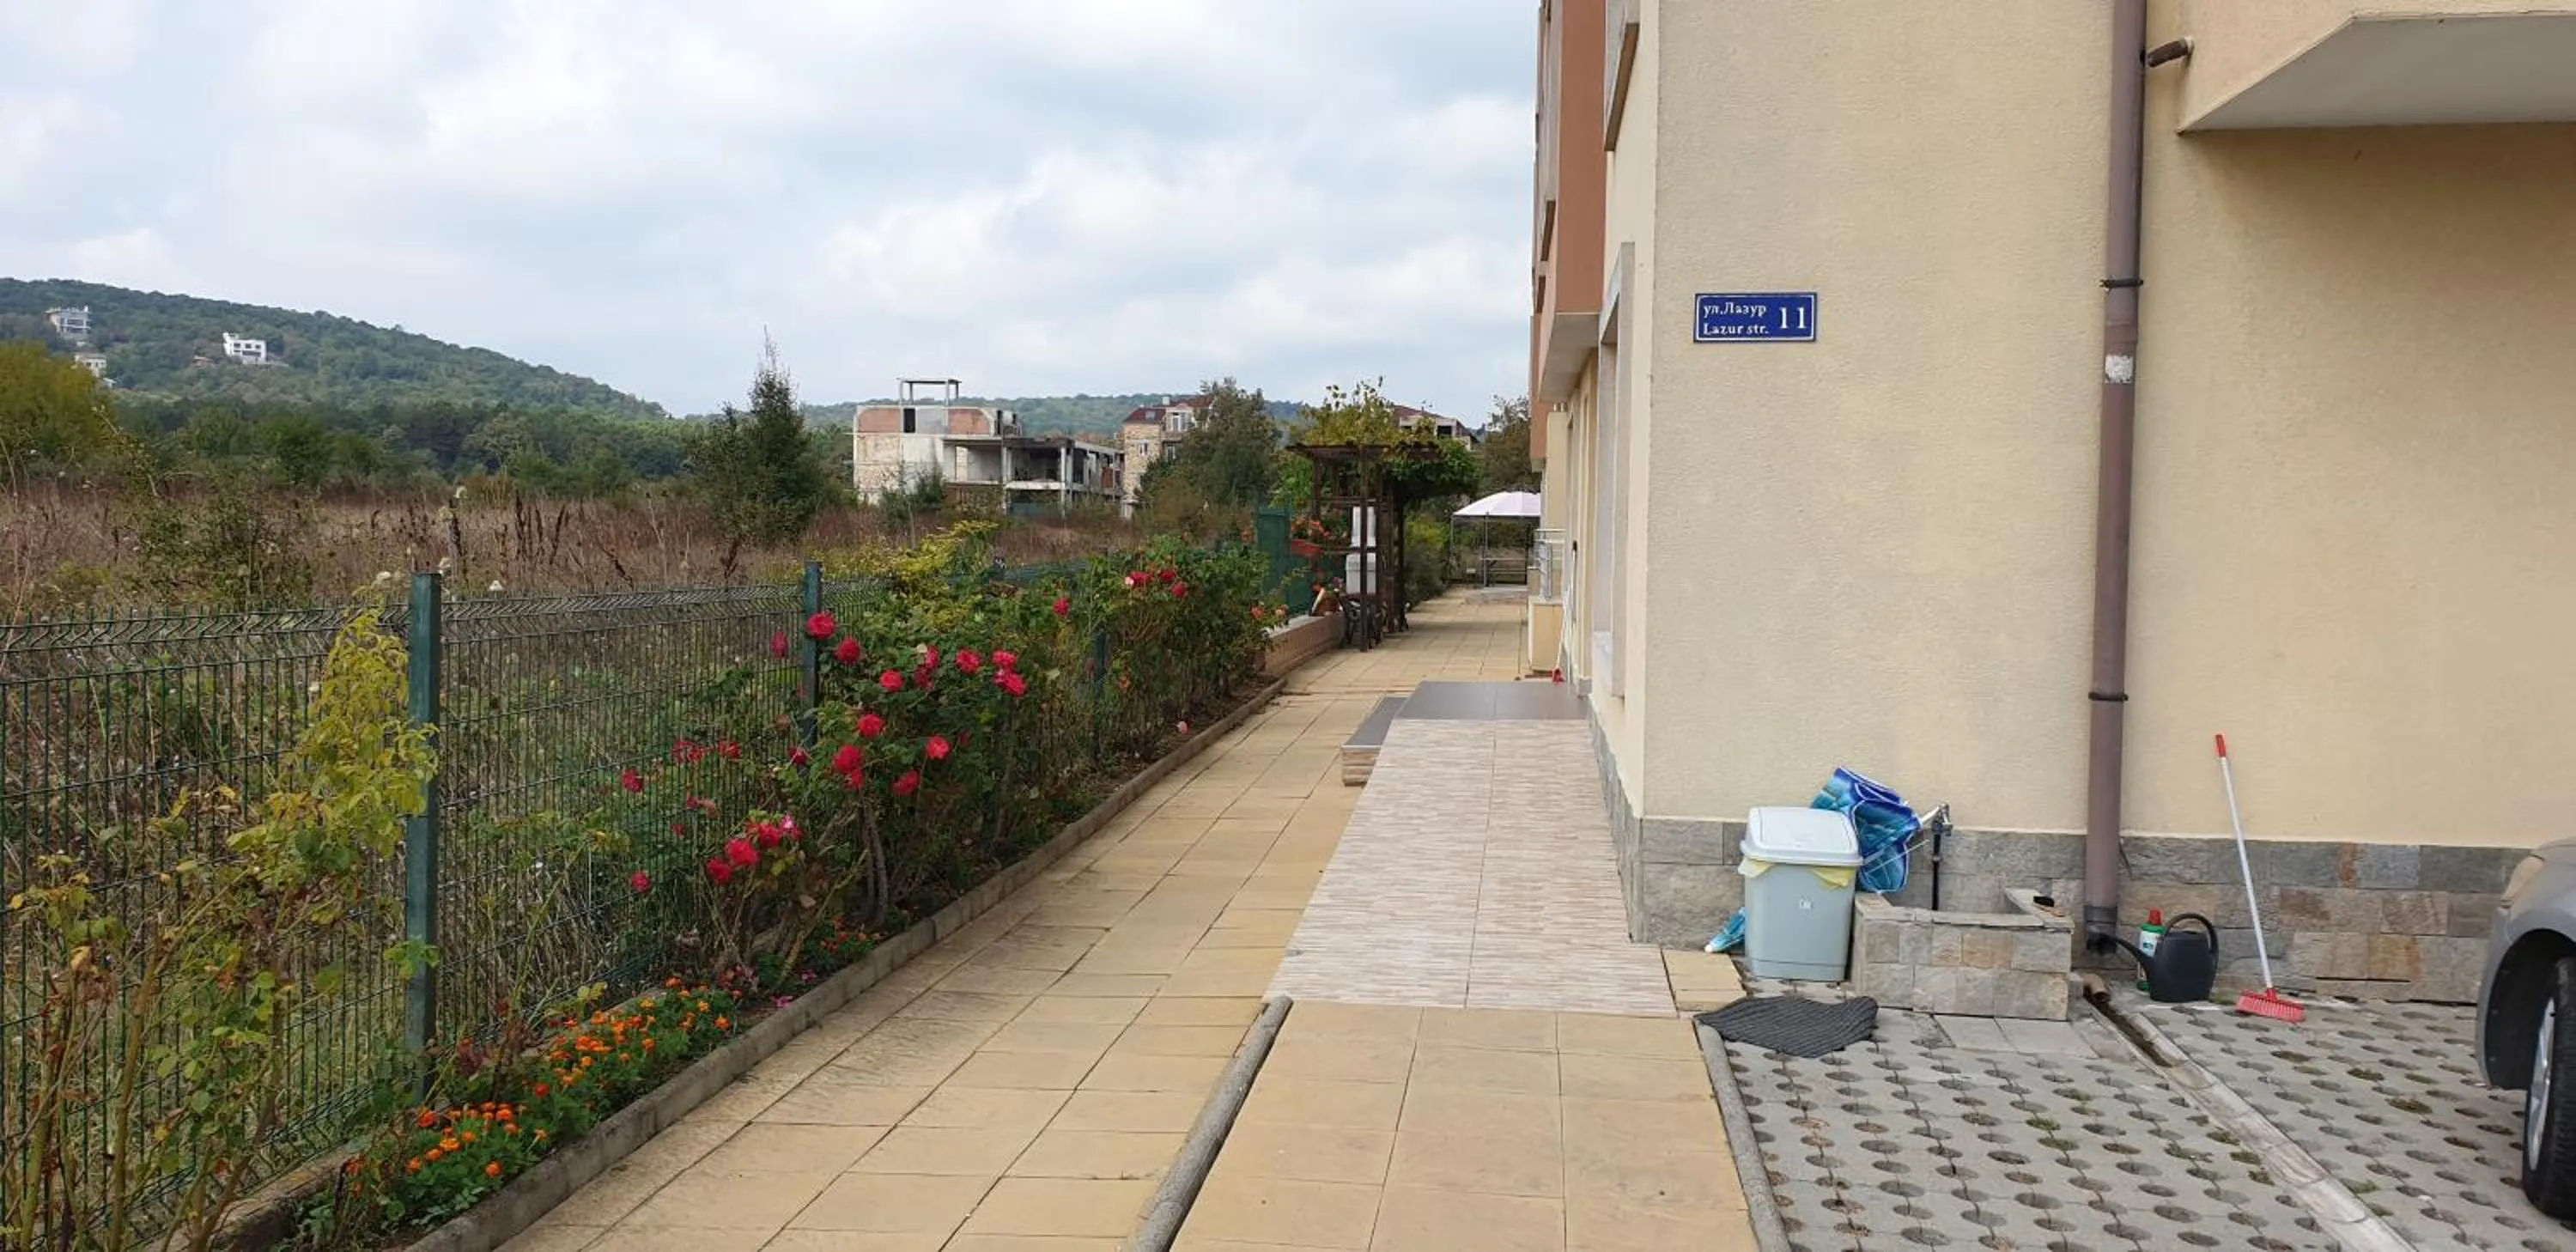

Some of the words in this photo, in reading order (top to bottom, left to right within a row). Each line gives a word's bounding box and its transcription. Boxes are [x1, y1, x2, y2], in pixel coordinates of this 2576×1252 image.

[1704, 302, 1766, 318] ул.Лазур
[1779, 307, 1807, 329] 11
[1704, 323, 1743, 335] Lazur
[1747, 323, 1769, 335] str.
